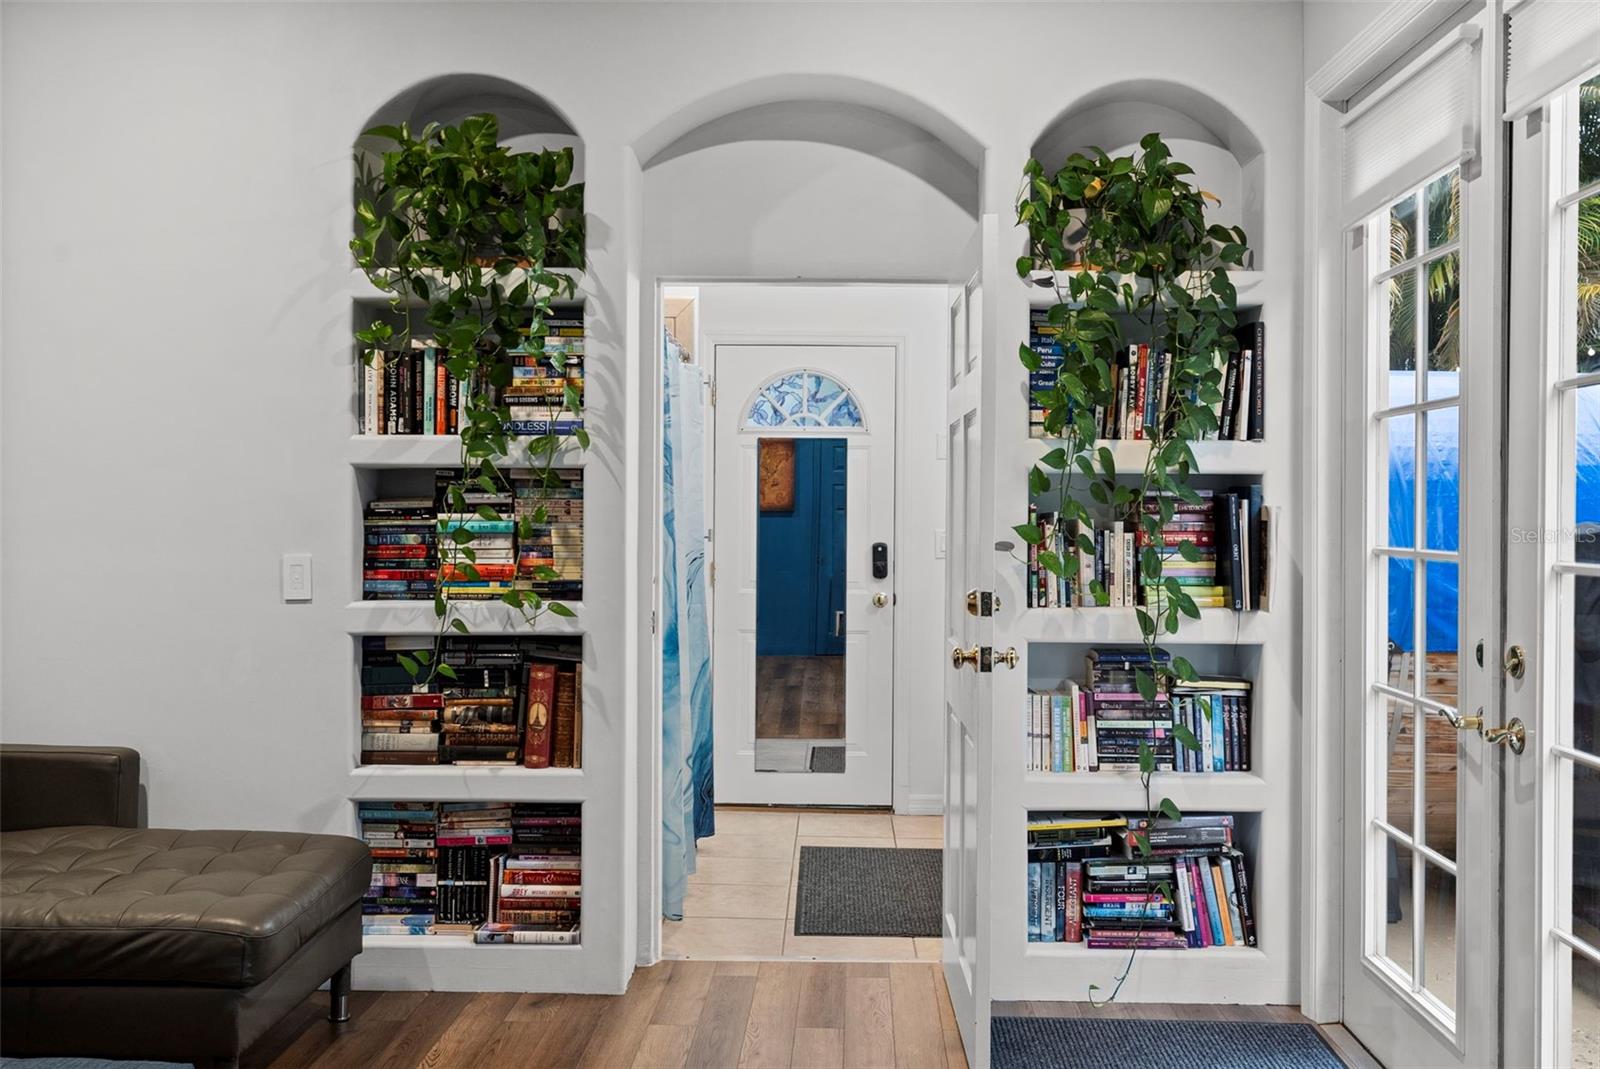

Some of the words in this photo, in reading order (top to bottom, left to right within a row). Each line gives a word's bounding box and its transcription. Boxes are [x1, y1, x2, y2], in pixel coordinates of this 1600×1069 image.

[1041, 336, 1056, 344] Italy
[390, 360, 398, 388] JOHN
[390, 390, 398, 422] ADAMS
[502, 422, 546, 431] NDLESS
